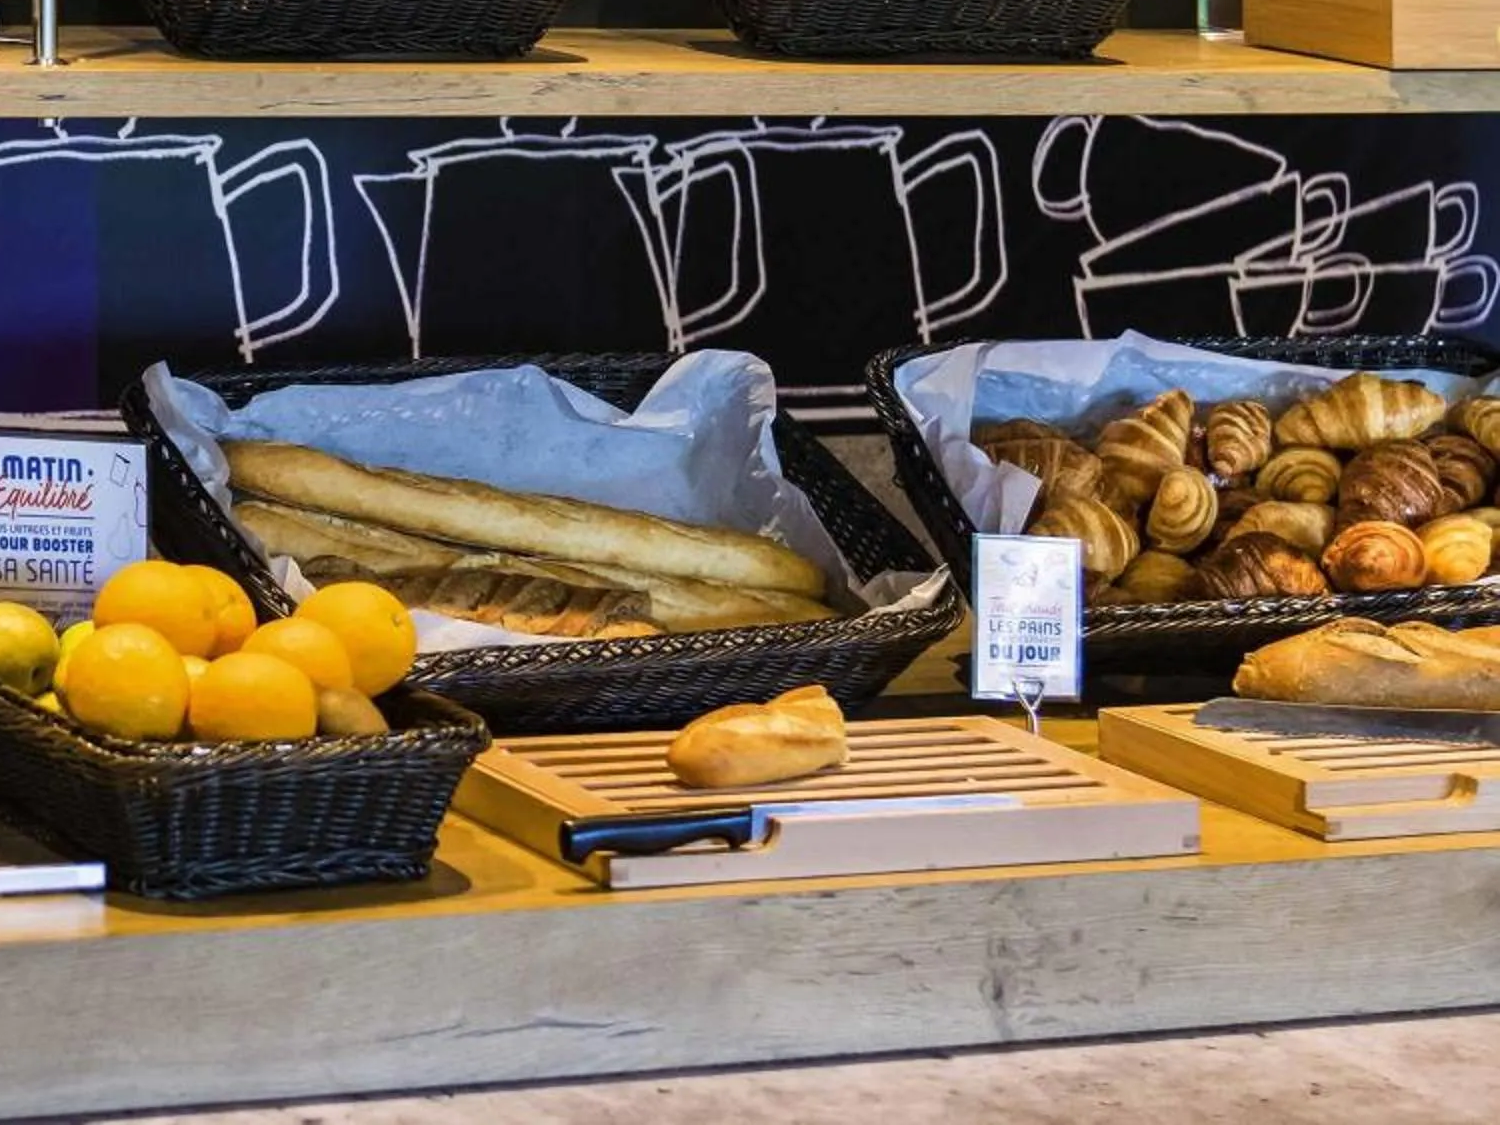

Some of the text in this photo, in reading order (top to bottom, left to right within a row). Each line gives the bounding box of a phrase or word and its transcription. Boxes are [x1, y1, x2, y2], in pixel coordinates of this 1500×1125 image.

[2, 455, 82, 482] MATIN
[33, 537, 94, 554] BOOSTER
[25, 555, 94, 585] SANTÉ
[989, 619, 1062, 636] LES PAINS
[989, 644, 1061, 663] DU JOUR
